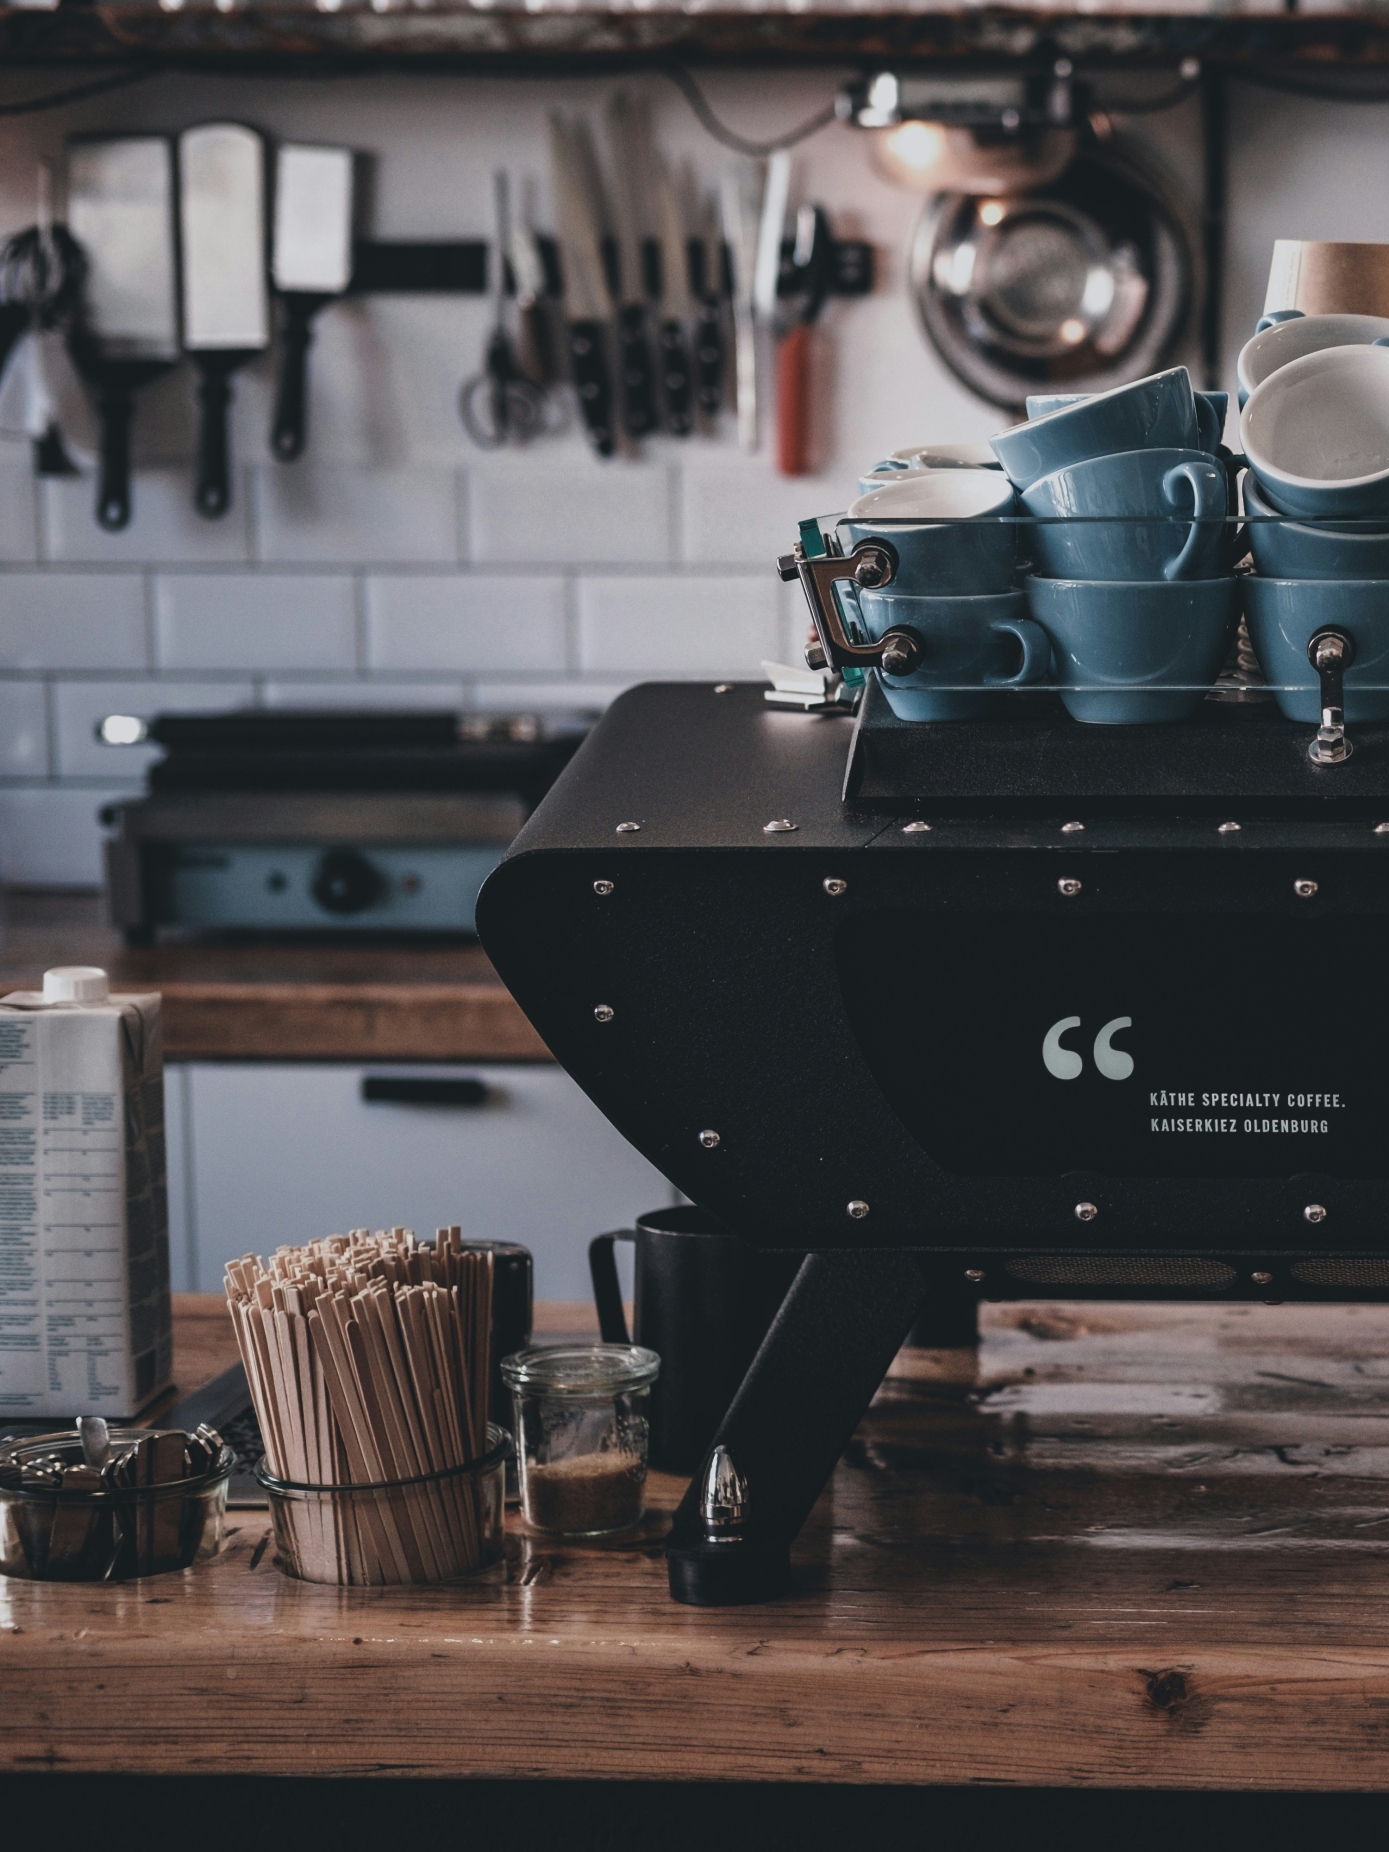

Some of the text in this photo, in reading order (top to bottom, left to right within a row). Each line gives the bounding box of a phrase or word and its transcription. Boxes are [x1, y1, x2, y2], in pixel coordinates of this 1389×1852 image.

[1202, 1093, 1280, 1107] SPECIALTY
[1287, 1093, 1346, 1108] COFFEE.
[1150, 1118, 1328, 1133] KAISERKIEZ OLDENBURG
